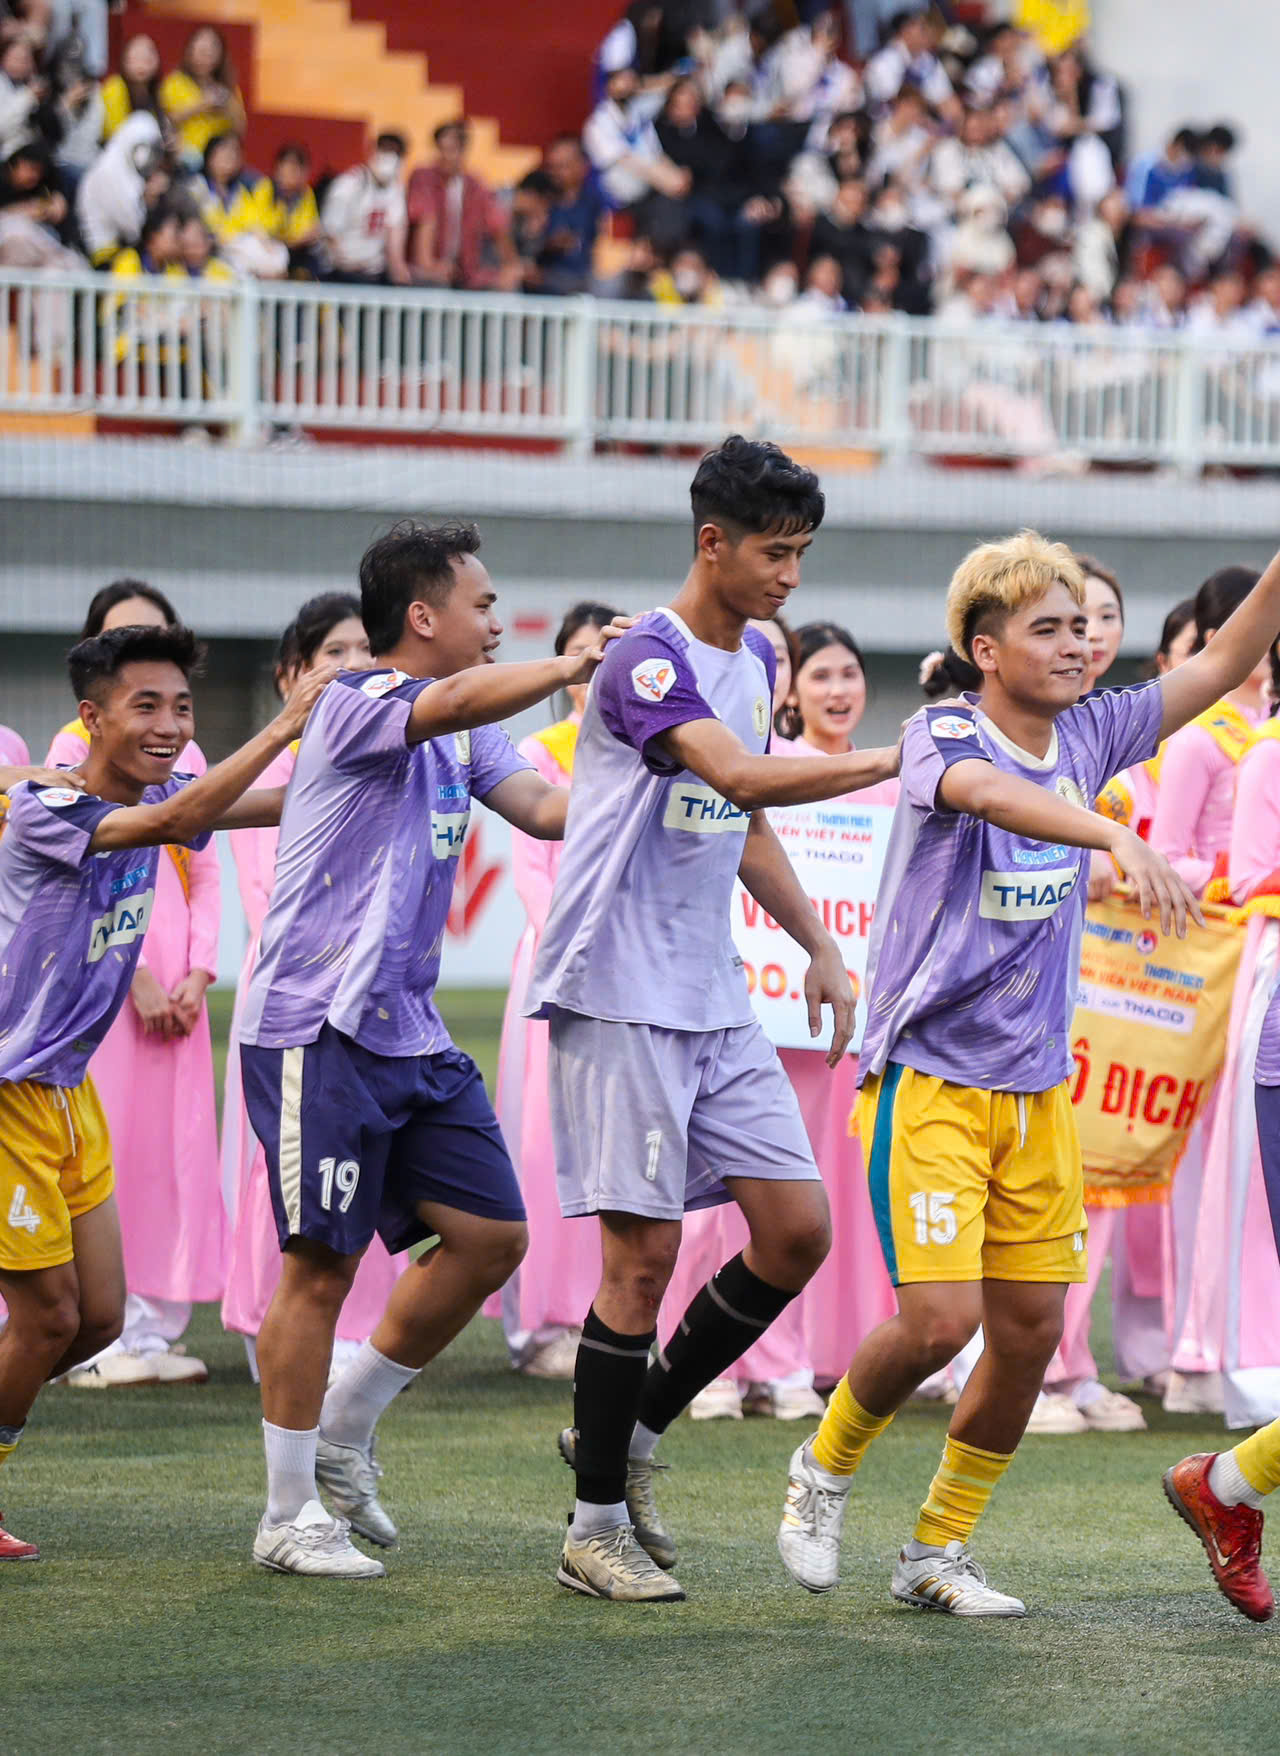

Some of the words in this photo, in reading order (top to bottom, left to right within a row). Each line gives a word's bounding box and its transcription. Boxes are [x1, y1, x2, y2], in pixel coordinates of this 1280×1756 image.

[840, 831, 873, 843] NAM
[993, 876, 1077, 907] THAC
[1125, 1000, 1185, 1024] THACO
[1100, 1061, 1206, 1133] ĐỊCH
[646, 1130, 663, 1181] 1
[8, 1184, 42, 1233] 4
[318, 1156, 360, 1213] 19
[909, 1191, 957, 1245] 15
